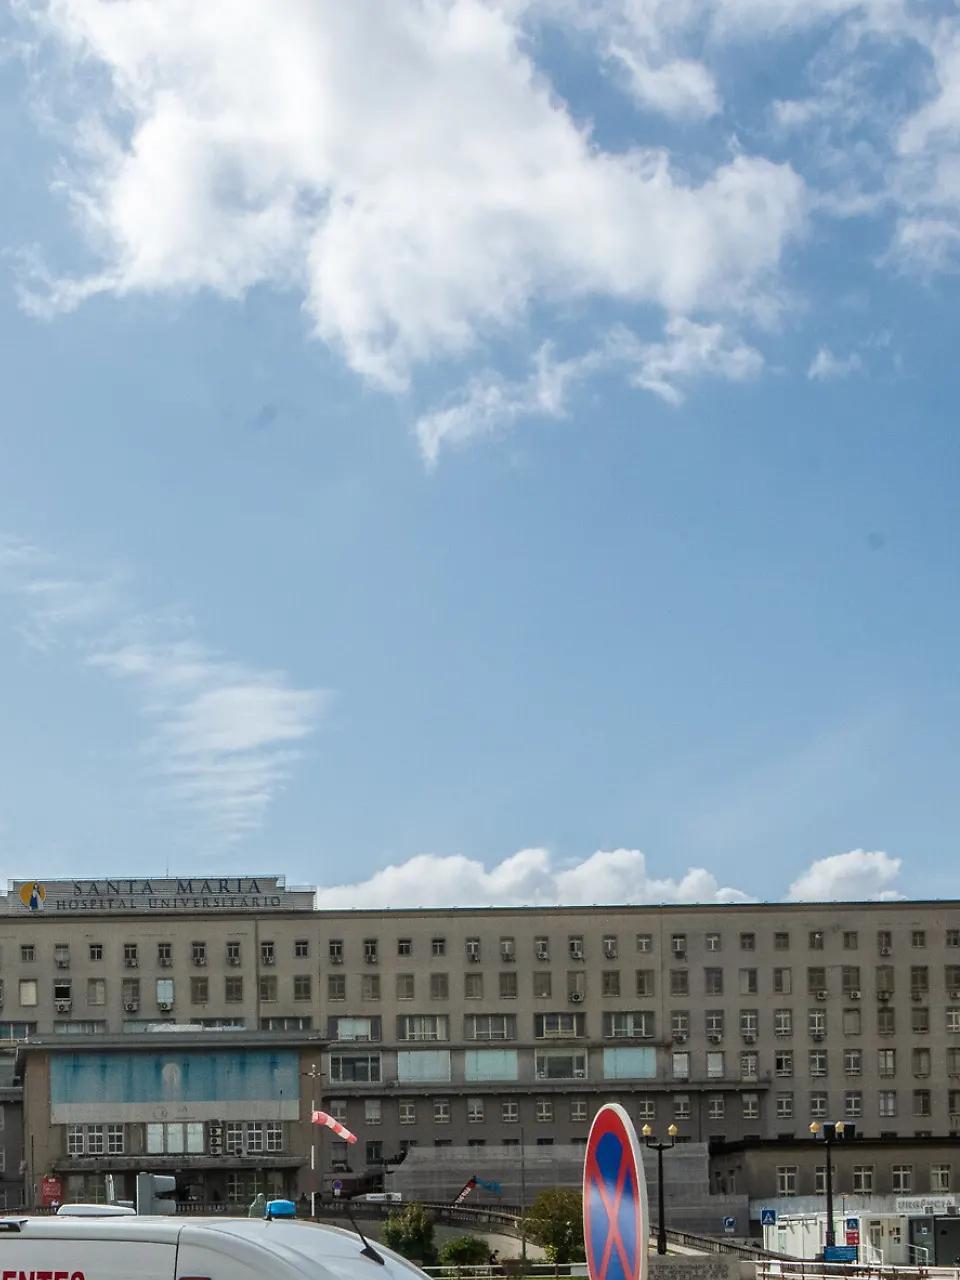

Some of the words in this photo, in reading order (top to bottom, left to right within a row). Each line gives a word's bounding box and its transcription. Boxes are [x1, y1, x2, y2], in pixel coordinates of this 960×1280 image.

[73, 879, 154, 896] SANTA
[176, 878, 262, 895] MARIA
[56, 899, 137, 910] HOSPITAL
[148, 896, 281, 909] UNIVERSITÁRIO
